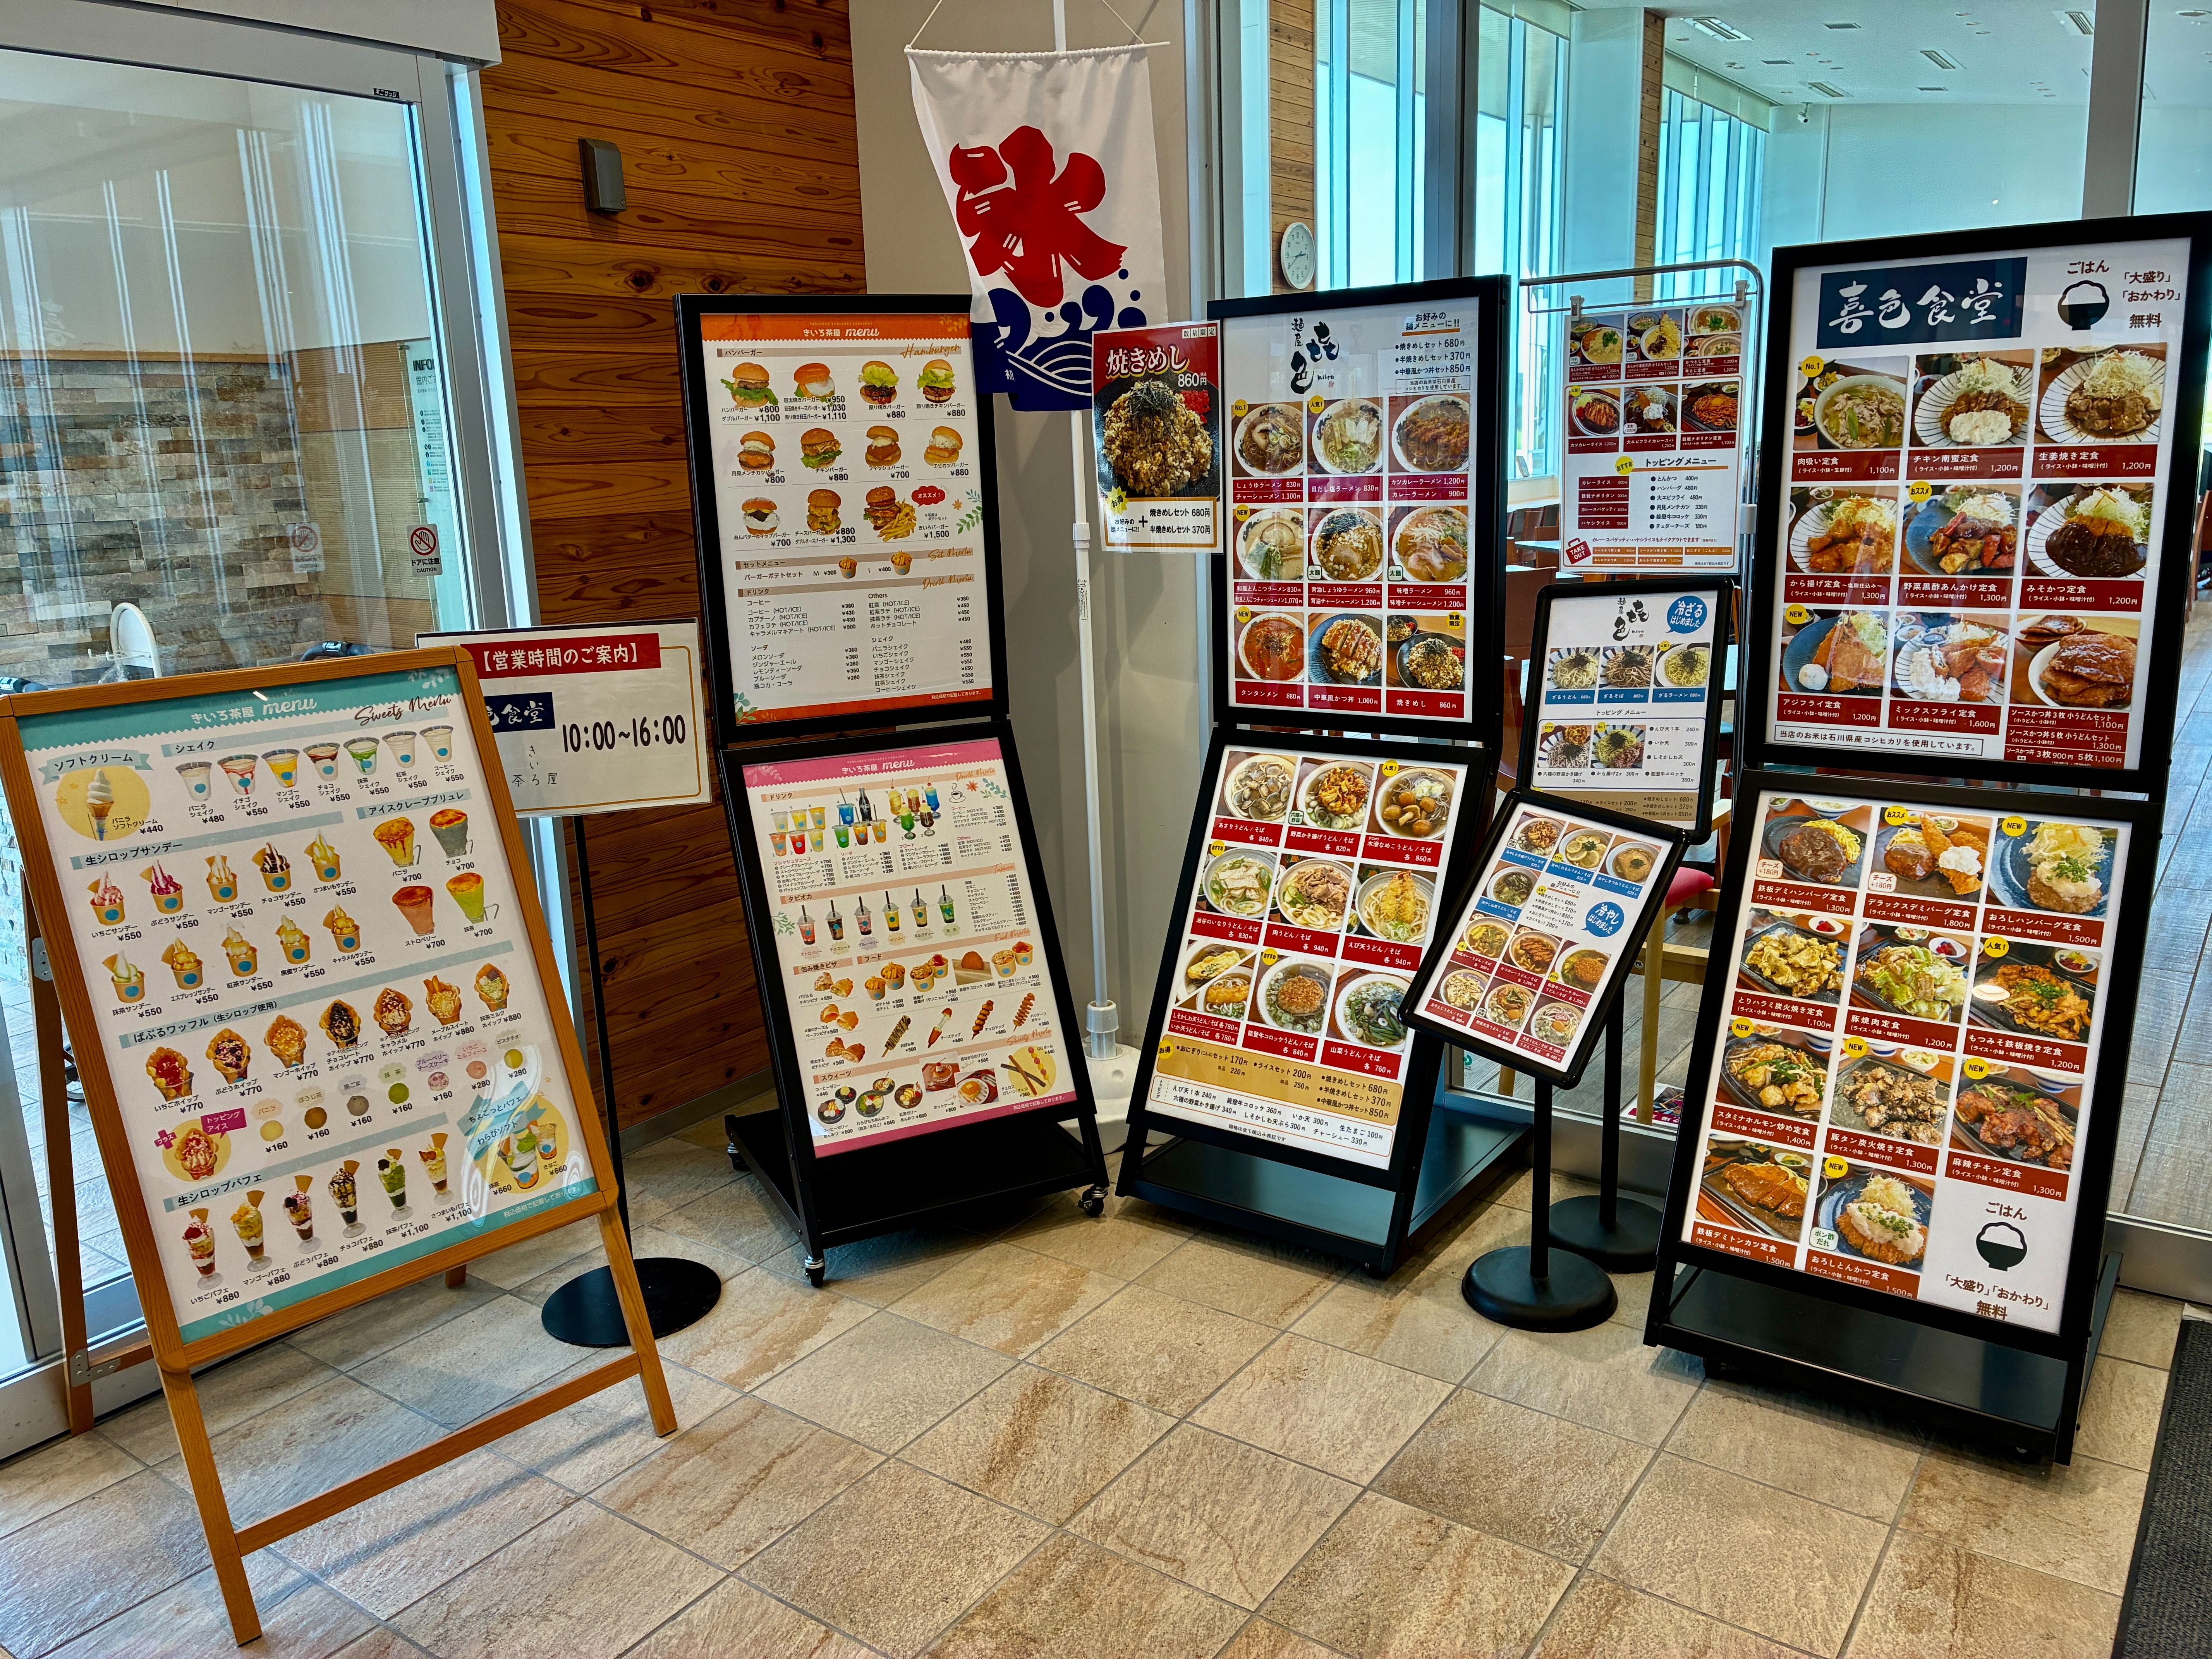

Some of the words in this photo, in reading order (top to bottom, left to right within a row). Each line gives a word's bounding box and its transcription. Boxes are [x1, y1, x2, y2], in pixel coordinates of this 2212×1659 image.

[949, 125, 1128, 308] 氷
[2067, 260, 2109, 275] ごはん
[2124, 271, 2171, 285] 「大盛り」
[1828, 278, 2003, 335] 喜色食堂
[1415, 312, 1446, 321] お好みの
[2129, 314, 2162, 329] 無料
[802, 328, 841, 337] きいろ茶屋
[845, 326, 880, 337] menu
[1182, 326, 1216, 338] 数量限定
[1400, 340, 1442, 350] 焼きめしセット
[1444, 338, 1465, 348] 680円
[899, 343, 961, 358] Hamburger
[1106, 345, 1190, 378] 焼きめし
[1400, 353, 1449, 363] 半焼きめしセット
[1449, 352, 1470, 361] 370円
[1399, 365, 1450, 376] 中華風かつ丼セット
[1449, 364, 1470, 373] 850円
[754, 414, 780, 423] ¥1,100
[1797, 457, 1839, 467] 肉吸い定食
[1913, 453, 1979, 464] チキン南蛮定食
[2039, 451, 2099, 461] 生姜焼き定食
[1645, 457, 1717, 468] トッピングメニュー
[890, 471, 910, 479] ¥700
[1869, 466, 1895, 475] 1,100円
[1443, 477, 1465, 485] 1,200円
[1448, 489, 1465, 498] 900円
[1150, 508, 1190, 517] 焼きめしセット
[924, 530, 950, 539] ¥1,500
[1150, 526, 1190, 534] 半焼きめしセット
[1570, 545, 1585, 556] TAKE
[1573, 551, 1586, 560] OUT
[744, 571, 803, 580] バーガーポテトセット
[1790, 580, 1841, 588] から揚げ定食
[1903, 582, 1997, 592] 野菜黒酢あんかけ定食
[2026, 584, 2087, 595] みそかつ定食
[1674, 601, 1703, 617] 冷ざる
[1670, 616, 1700, 628] はじめました
[484, 642, 637, 672] 【営業時間のご案内】
[1314, 694, 1354, 703] 中華風かつ丼
[1358, 697, 1378, 705] 1,000円
[1396, 699, 1426, 708] 焼きめし
[1439, 701, 1456, 709] 860円
[1783, 699, 1841, 709] アジフライ定食
[191, 706, 255, 725] きいろ茶屋
[262, 698, 318, 716] menu
[354, 705, 403, 726] Sweets
[408, 694, 452, 713] Menu
[1895, 705, 1977, 719] ミックスフライ定食
[175, 740, 215, 754] シェイク
[55, 753, 133, 770] ソフトクリーム
[842, 764, 878, 774] きいろ茶屋
[882, 759, 915, 771] menu
[769, 792, 792, 801] ドリンク
[140, 824, 163, 834] ¥440
[85, 842, 183, 866] 生シロップサンデー
[261, 891, 303, 904] チョコサンデー
[788, 893, 812, 903] タピオカ
[1757, 884, 1847, 903] 鉄板デミハンバーグ定食
[284, 898, 306, 908] ¥550
[1867, 898, 1971, 918] デラックスデミバーグ定食
[1595, 902, 1618, 925] 冷やし
[1587, 914, 1613, 934] はじめました
[1943, 919, 1971, 929] 1,800円
[1988, 913, 2083, 932] おろしハンバーグ定食
[91, 925, 138, 938] いちごサンデー
[118, 931, 142, 942] ¥550
[405, 935, 437, 946] ストロベリー
[426, 939, 446, 949] ¥700
[864, 953, 883, 962] フード
[431, 1021, 469, 1034] メープルスイート
[1851, 1014, 1901, 1030] 豚焼肉定食
[133, 1017, 209, 1043] ばぶるワッフル
[1969, 1033, 2063, 1056] もつみそ鉄板焼き定食
[821, 1070, 852, 1081] スウィーツ
[1258, 1061, 1291, 1075] ライスセット
[1292, 1069, 1312, 1080] 200円
[155, 1095, 199, 1111] いちごホイップ
[180, 1102, 204, 1114] ¥770
[206, 1112, 240, 1123] トッピング
[1717, 1110, 1811, 1137] スタミナホルモン炒め定食
[207, 1123, 228, 1131] アイス
[1952, 1157, 2023, 1179] 麻辣チキン定食
[177, 1173, 263, 1206] 生シロップパフェ
[431, 1202, 470, 1219] さつまいもパフェ
[445, 1208, 472, 1222] ¥1,100
[1811, 1255, 1890, 1281] おろしとんかつ定食
[191, 1287, 229, 1305] いちごパフェ
[216, 1290, 240, 1305] ¥880
